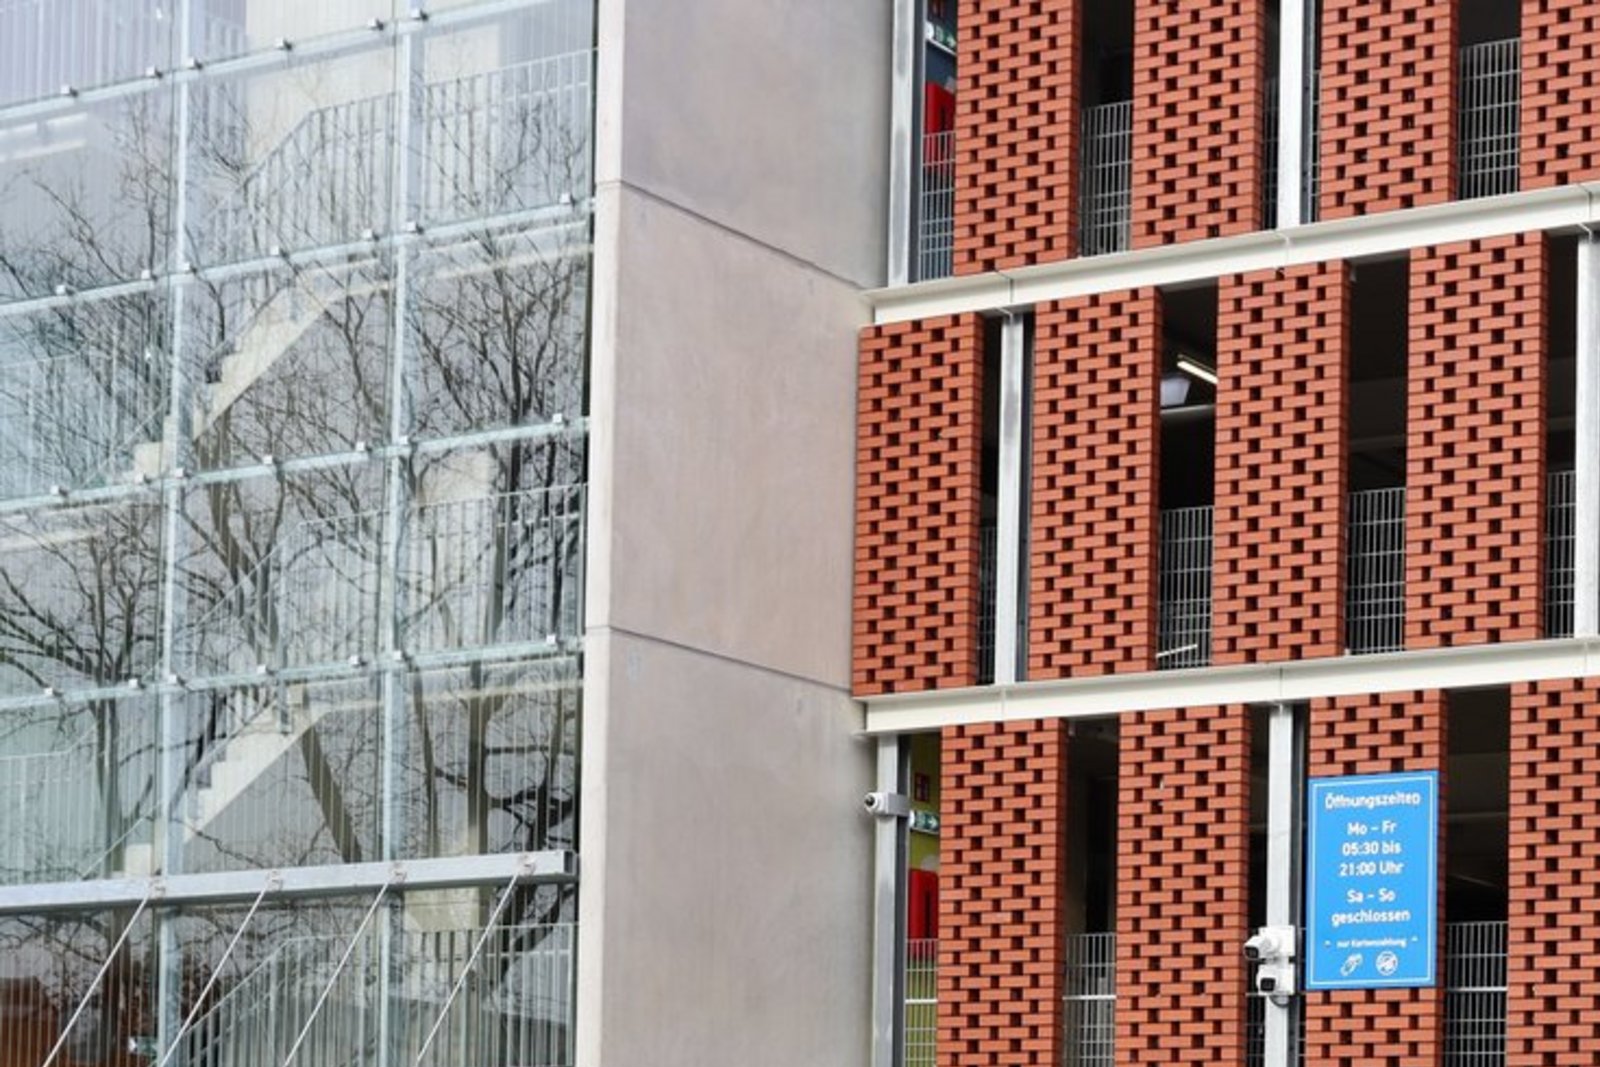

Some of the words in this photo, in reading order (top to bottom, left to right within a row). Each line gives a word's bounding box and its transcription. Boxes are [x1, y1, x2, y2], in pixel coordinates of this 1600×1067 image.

[1325, 791, 1421, 810] Öffnungszeiten
[1347, 822, 1368, 836] Mo
[1382, 820, 1397, 834] Fr
[1342, 842, 1379, 855] 05:30
[1382, 840, 1402, 854] bis
[1340, 862, 1376, 876] 21:00
[1380, 861, 1404, 875] Uhr
[1347, 889, 1364, 903] Sa
[1378, 888, 1396, 901] So
[1331, 909, 1411, 927] geschlossen
